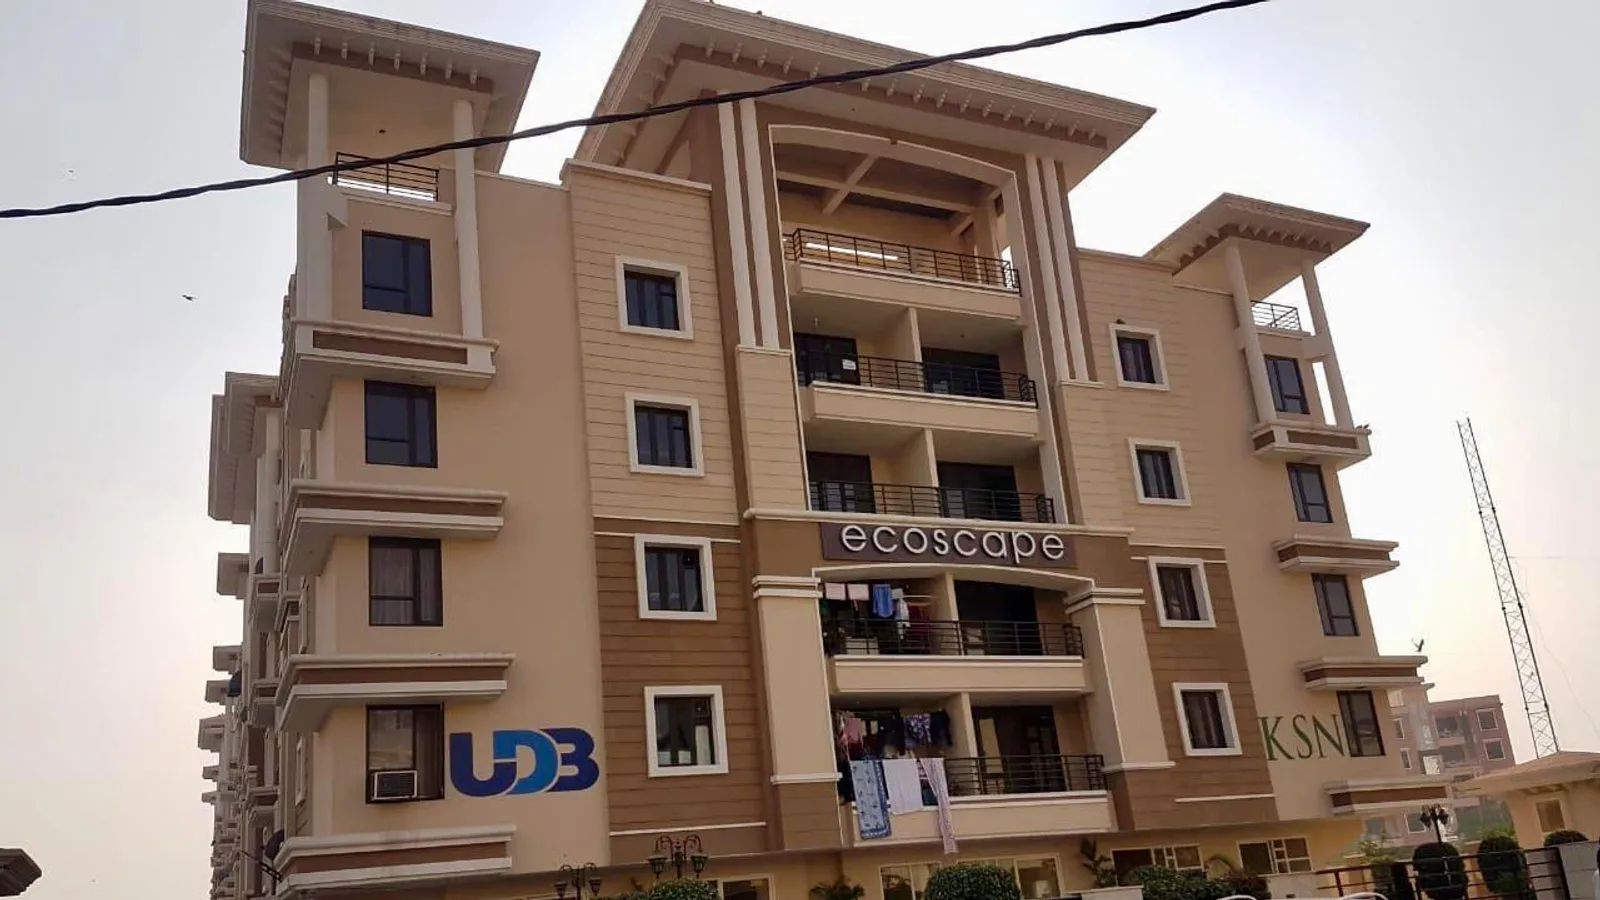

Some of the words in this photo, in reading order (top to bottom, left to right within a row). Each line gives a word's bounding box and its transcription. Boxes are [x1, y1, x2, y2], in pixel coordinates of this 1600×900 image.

[842, 525, 1065, 564] ecoscape
[1257, 713, 1346, 761] KSN
[450, 727, 599, 797] UDB
